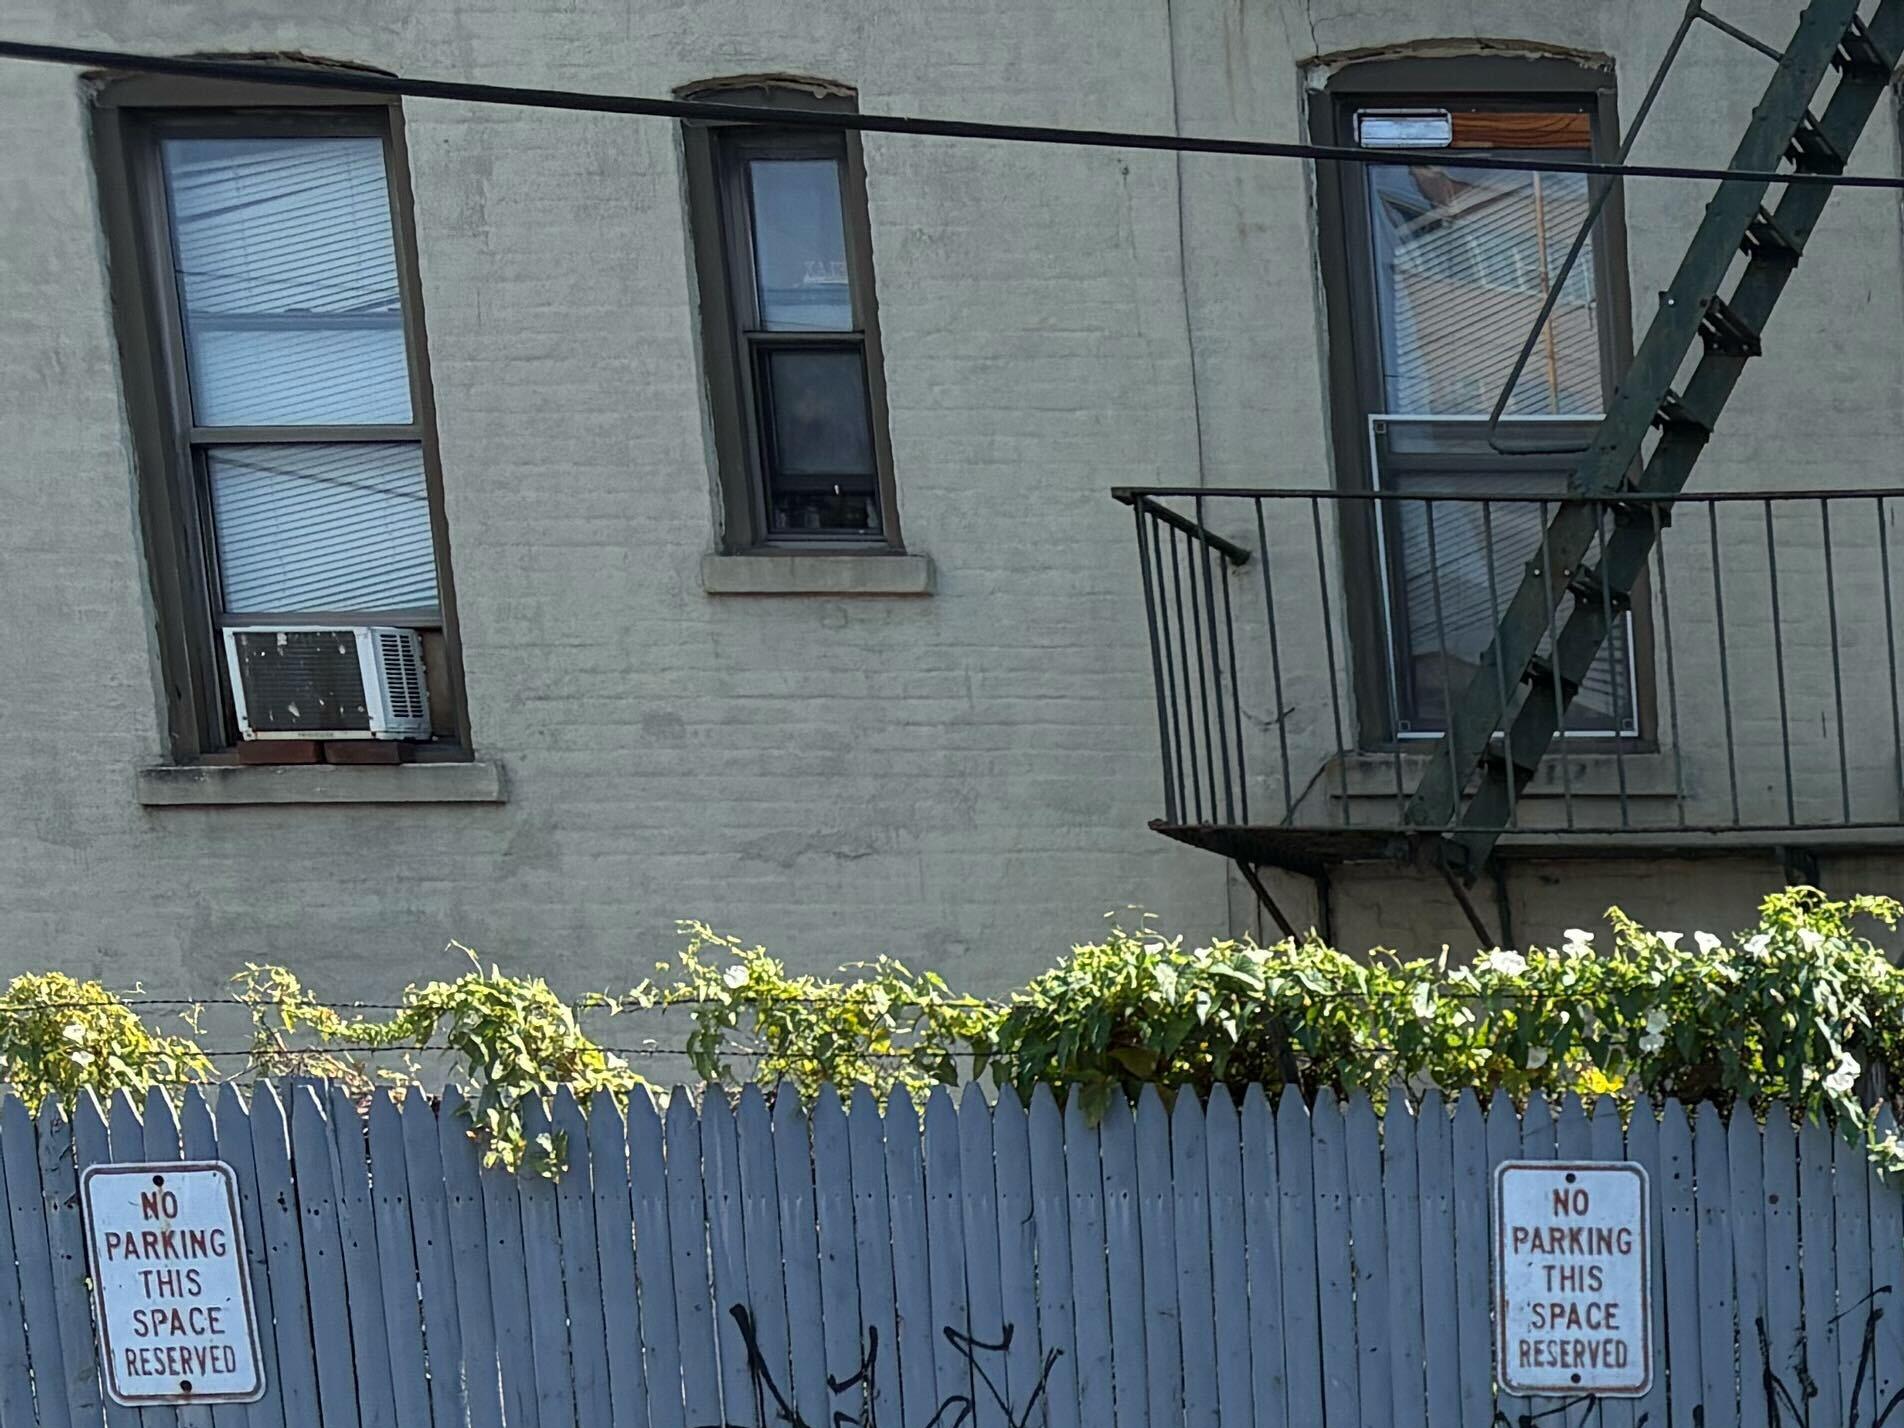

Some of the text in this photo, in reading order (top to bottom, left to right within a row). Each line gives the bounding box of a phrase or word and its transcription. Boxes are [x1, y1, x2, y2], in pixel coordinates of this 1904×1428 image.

[141, 1191, 178, 1220] NO
[1552, 1188, 1589, 1217] NO
[104, 1228, 227, 1261] PARKING
[1512, 1226, 1633, 1255] PARKING
[138, 1268, 202, 1299] THIS
[1542, 1264, 1603, 1293] THIS
[133, 1306, 225, 1337] SPACE
[1531, 1302, 1620, 1330] SPACE
[125, 1345, 236, 1377] RESERVED
[1519, 1338, 1628, 1369] RESERVED
